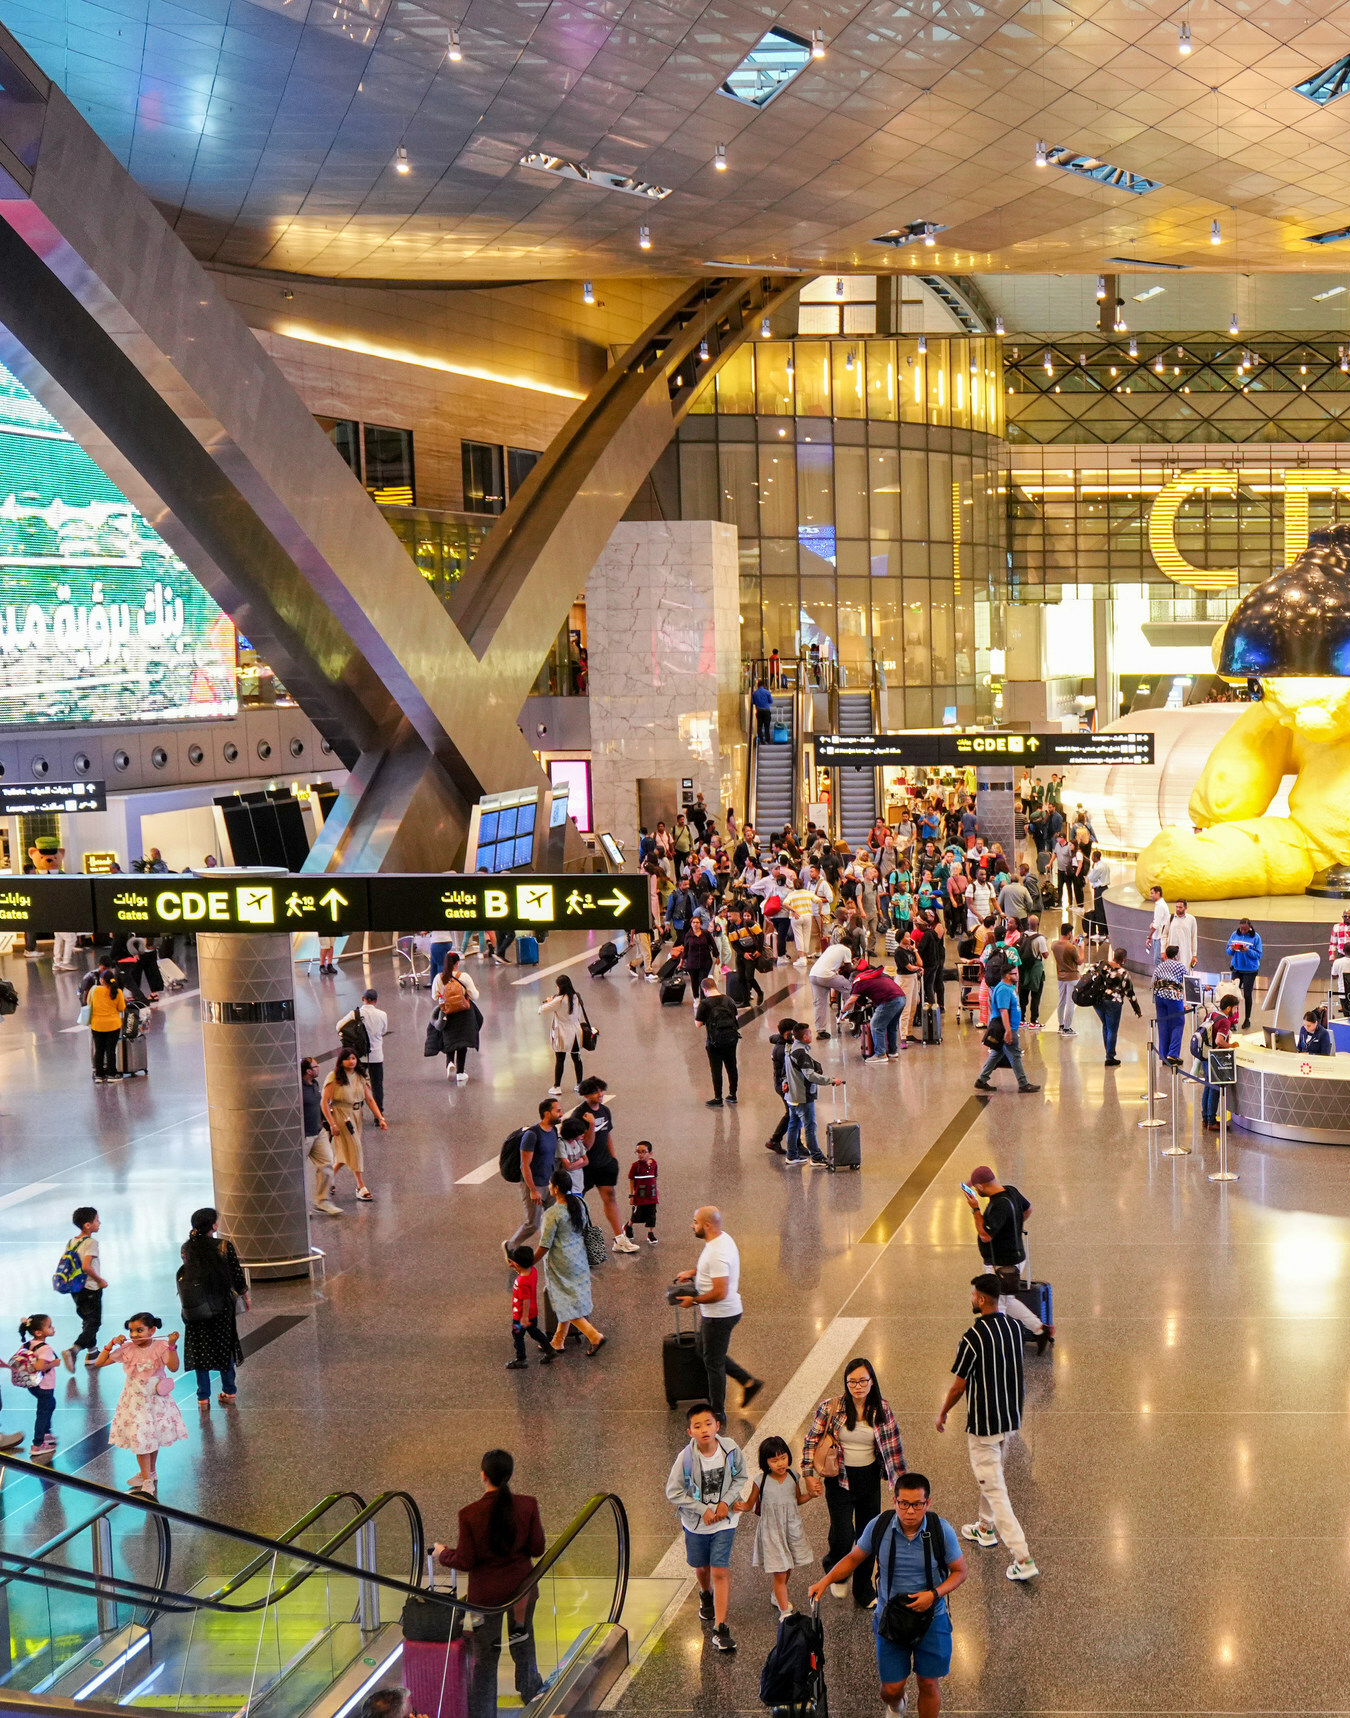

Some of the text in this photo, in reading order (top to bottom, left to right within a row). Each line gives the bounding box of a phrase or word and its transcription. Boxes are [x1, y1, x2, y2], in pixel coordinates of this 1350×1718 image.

[973, 738, 1007, 752] CDE
[113, 892, 149, 907] بوابات
[301, 895, 314, 906] 10
[441, 890, 477, 905] بوابات
[484, 890, 508, 918] B
[584, 894, 592, 903] 3
[155, 891, 230, 921] CDE
[117, 910, 149, 920] Gates
[445, 908, 477, 919] Gates
